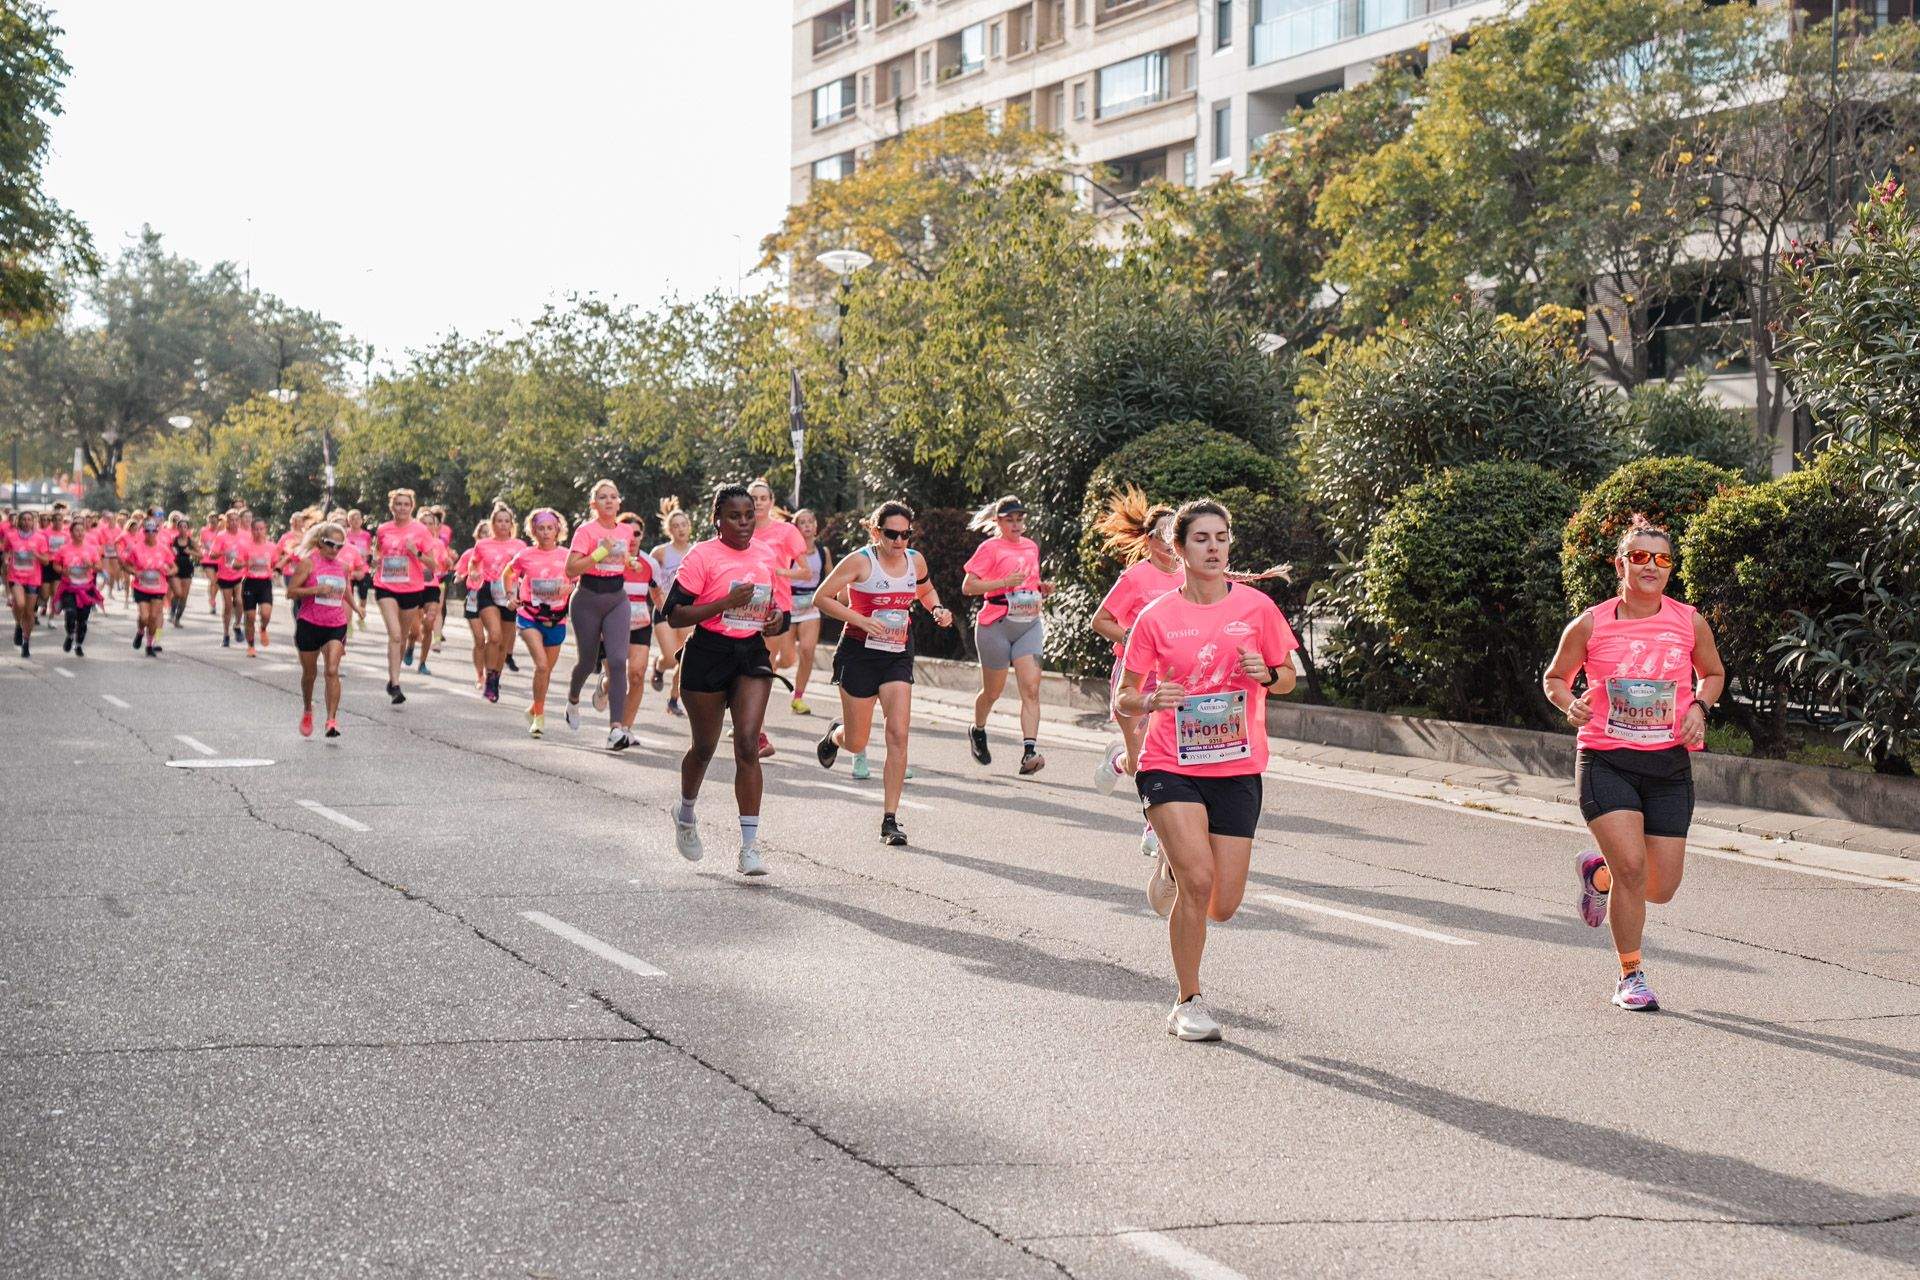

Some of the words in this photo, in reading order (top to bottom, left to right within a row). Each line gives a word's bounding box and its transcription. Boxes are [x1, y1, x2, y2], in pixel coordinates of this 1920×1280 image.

[1167, 628, 1199, 639] OYSHO
[1629, 707, 1653, 717] 016
[1202, 723, 1228, 736] 016
